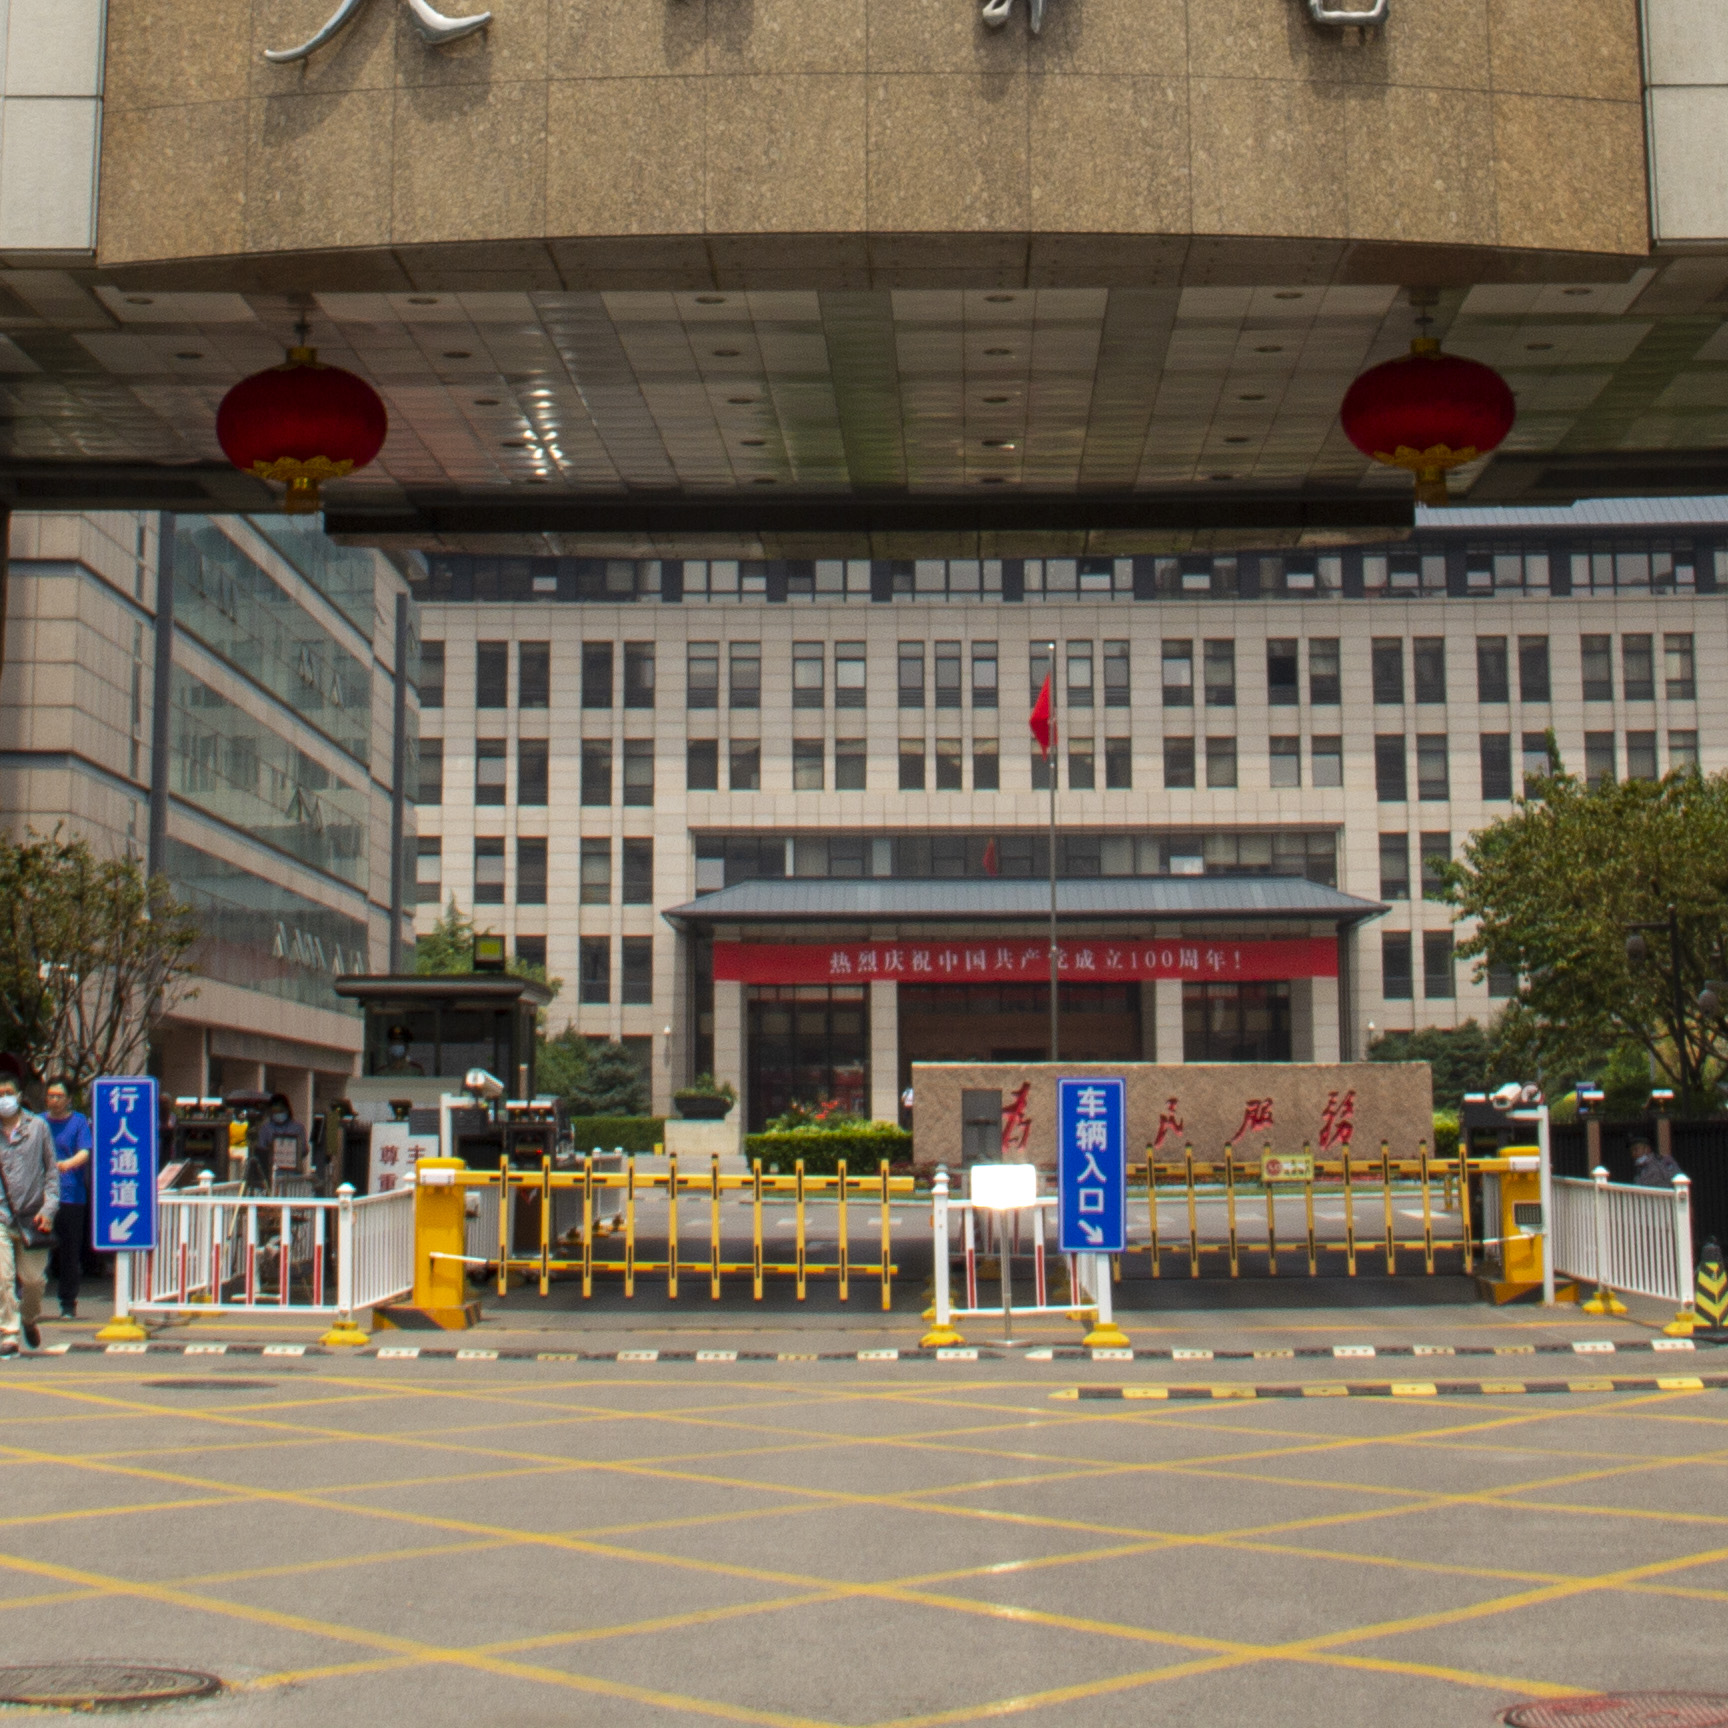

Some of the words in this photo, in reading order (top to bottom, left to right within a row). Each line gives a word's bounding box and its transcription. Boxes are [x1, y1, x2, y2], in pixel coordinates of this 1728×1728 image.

[109, 1086, 140, 1208] 行人通道
[1075, 1087, 1108, 1214] 车辆入口
